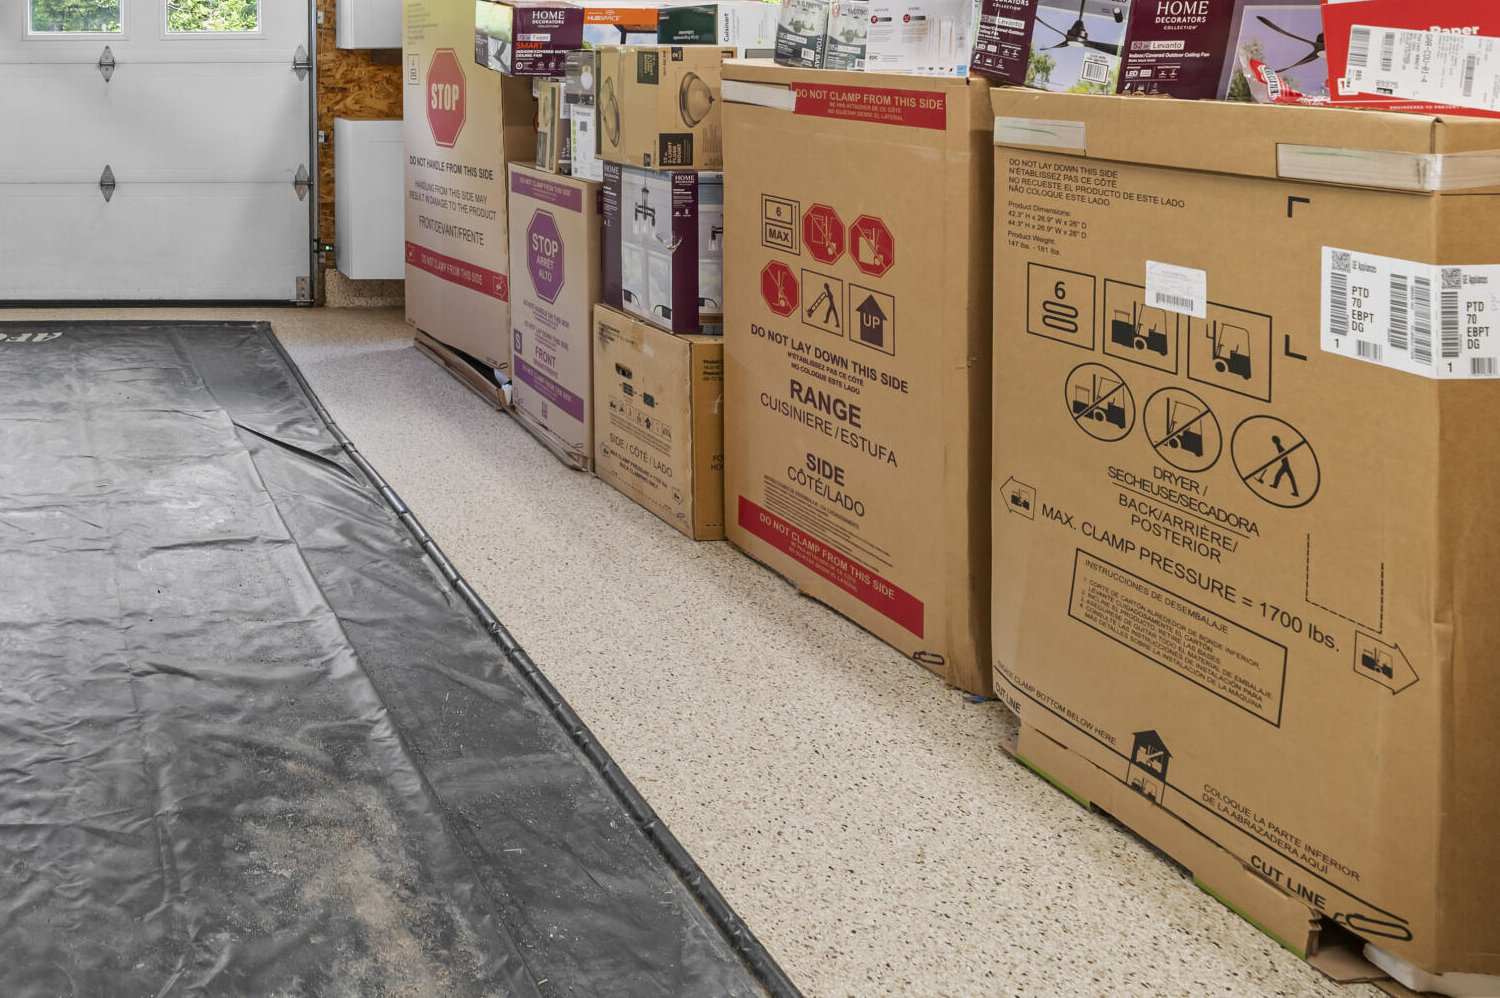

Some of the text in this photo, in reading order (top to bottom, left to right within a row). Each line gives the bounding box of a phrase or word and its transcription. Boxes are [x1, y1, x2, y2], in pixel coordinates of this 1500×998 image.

[532, 10, 565, 20] HOME
[1156, 1, 1209, 15] HOME
[998, 18, 1022, 28] Levanto
[1155, 16, 1206, 24] DECORATORS
[430, 82, 459, 110] STOP
[793, 88, 943, 109] DO NOT CLAMP FROM THIS SIDE
[409, 155, 493, 180] DO NOT HANDLE FROM THIS SIDE
[604, 164, 619, 174] HOME
[1009, 158, 1117, 178] DO NOT LAY DOWN THIS SIDE
[1009, 167, 1116, 188] N'ÉTABLISSEZ PAS CE CÔTÉ
[1008, 185, 1110, 206] NÃO COLOQUE ESTE LADO
[1009, 176, 1184, 207] NO RECUESTE EL PRODUCTO DE ESTE LADO
[775, 206, 781, 217] 6
[532, 233, 558, 258] STOP
[768, 228, 790, 243] MAX
[536, 255, 554, 270] ARRÊT
[539, 269, 552, 282] ALTO
[1055, 281, 1066, 300] 6
[1352, 286, 1369, 298] PTD
[1352, 298, 1362, 308] 70
[1467, 301, 1484, 312] PTD
[862, 313, 881, 329] UP
[1352, 310, 1374, 323] EBPT
[1352, 320, 1364, 333] DG
[1467, 314, 1477, 324] 70
[515, 333, 520, 350] S
[1467, 326, 1490, 337] EBPT
[1334, 338, 1339, 348] 1
[1467, 339, 1480, 349] DG
[535, 346, 556, 369] FRONT
[750, 323, 907, 393] DO NOT LAY DOWN THIS SIDE
[1448, 362, 1452, 373] 1
[790, 379, 862, 429] RANGE
[609, 432, 625, 449] SIDE
[630, 444, 649, 464] CÔTÉ
[653, 457, 672, 478] LADO
[806, 453, 844, 487] SIDE
[788, 466, 865, 517] CÔTÉ/LADO
[1153, 466, 1207, 496] DRYER /
[1108, 466, 1260, 537] SECHEUSE/SECADORA
[1119, 494, 1238, 553] BACK/ARRIÈRE/
[1131, 513, 1222, 563] POSTERIOR
[759, 512, 894, 598] DO NOT CLAMP FROM THIS SIDE
[1042, 504, 1340, 652] MAX. CLAMP PRESSURE = 1700 lbs.
[1085, 560, 1227, 631] INSTRUCCIONES DE DESEMBALAJE
[1014, 675, 1117, 745] CLAMP BOTTOM BELOW HERE
[1202, 793, 1328, 875] DE LA ABRAZADERA AQUI
[1203, 784, 1359, 880] COLOQUE LA PARTE INFERIOR
[1251, 855, 1326, 910] CUT LINE
